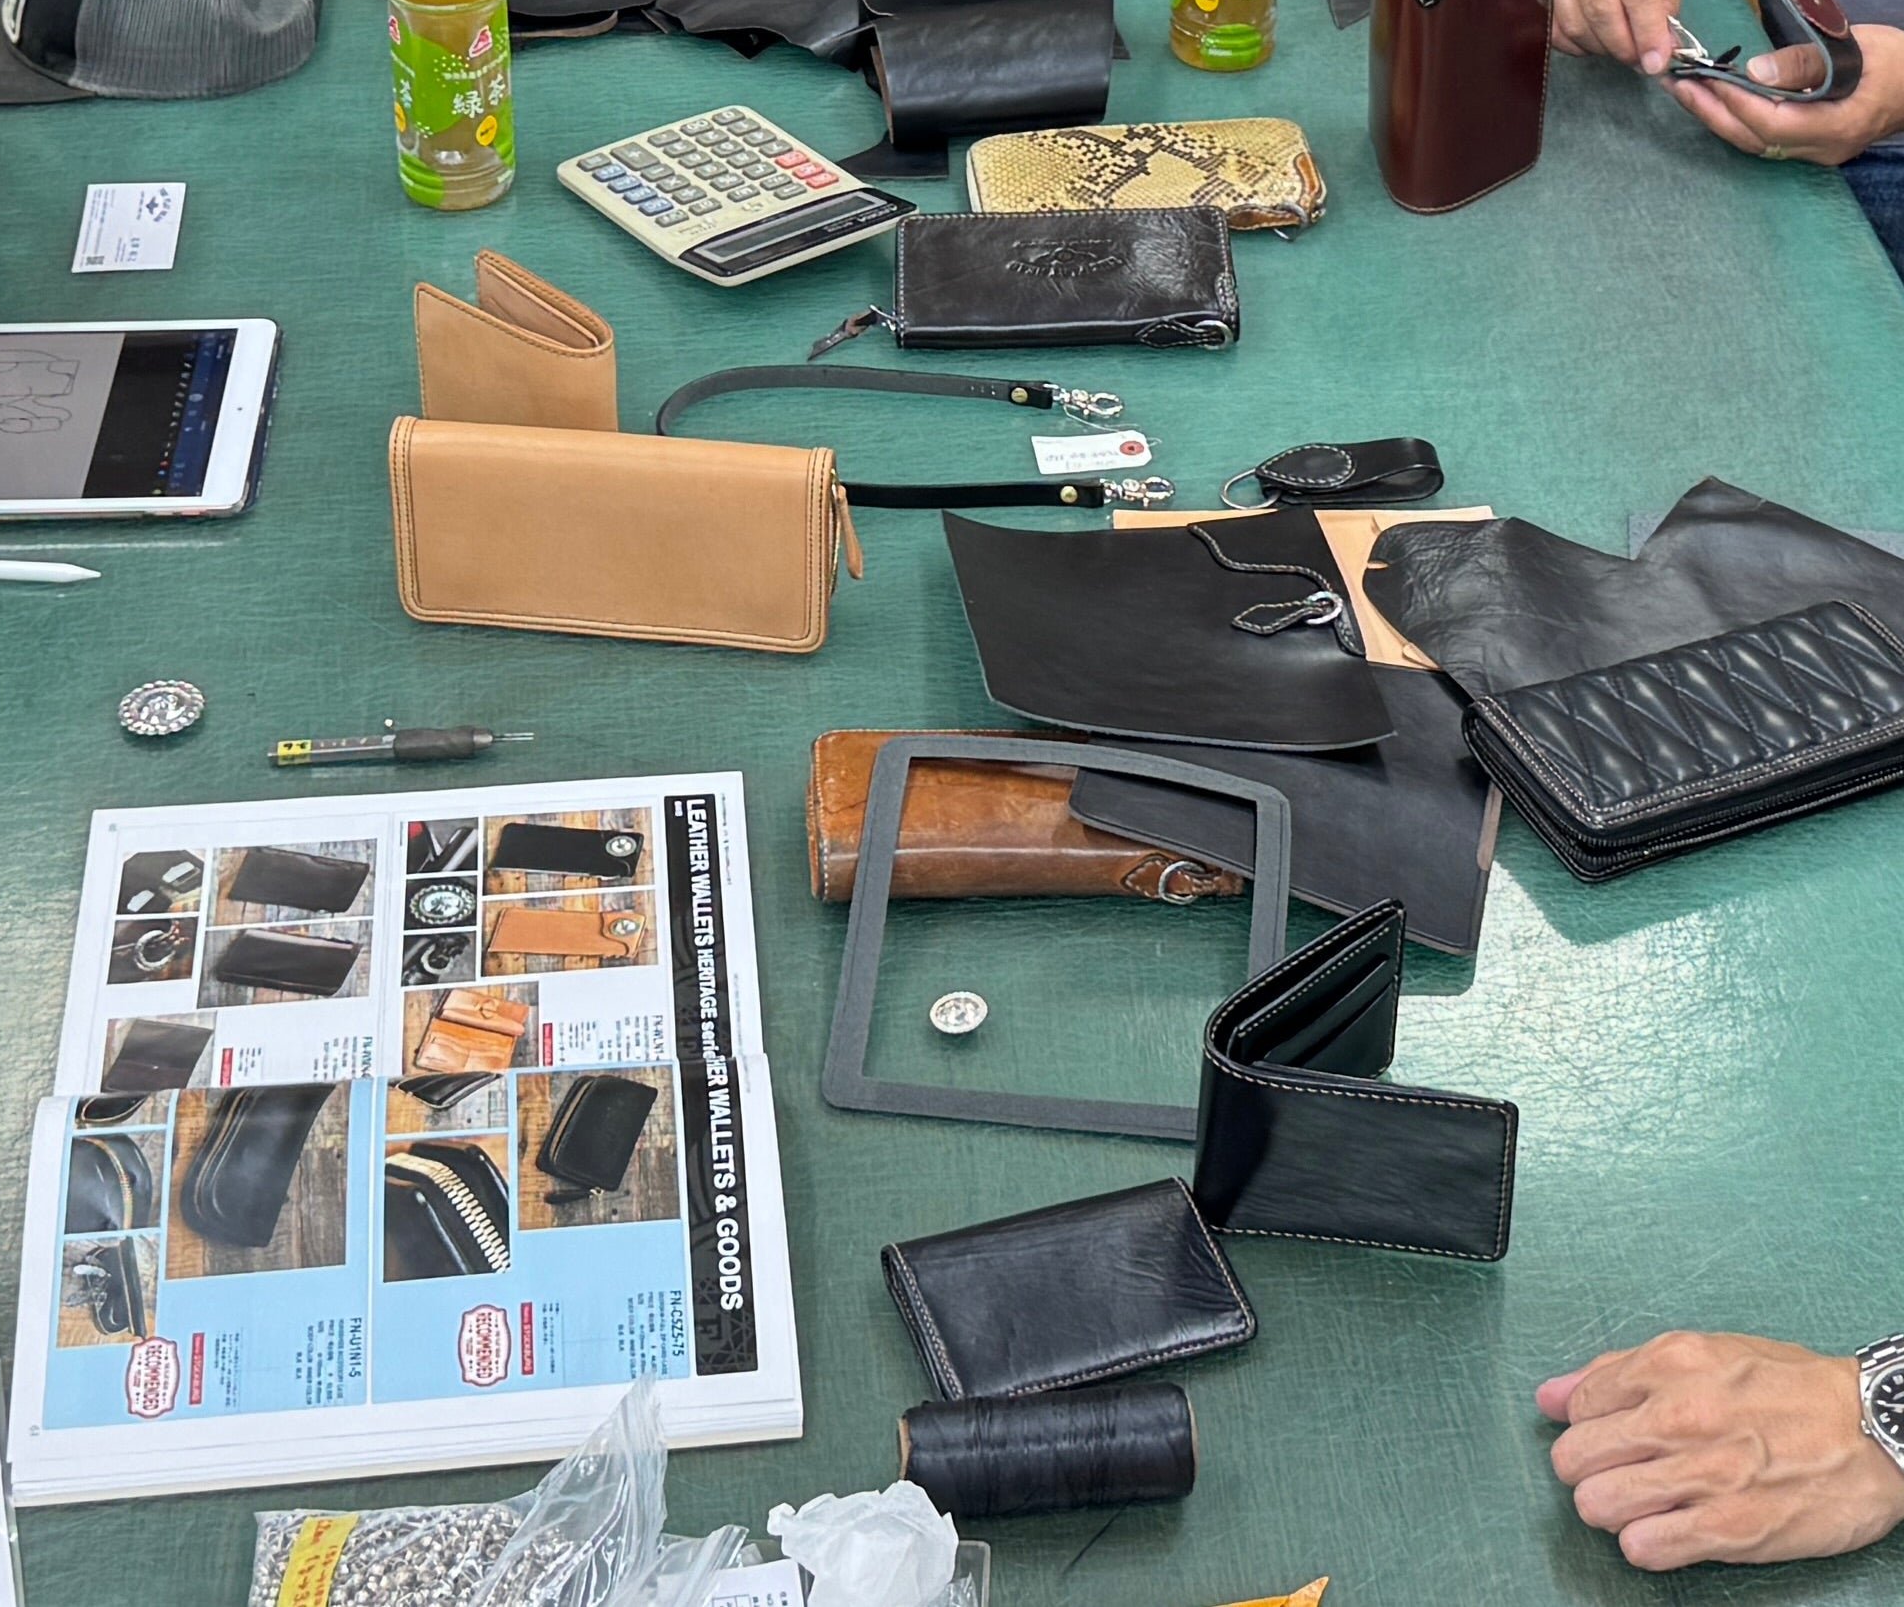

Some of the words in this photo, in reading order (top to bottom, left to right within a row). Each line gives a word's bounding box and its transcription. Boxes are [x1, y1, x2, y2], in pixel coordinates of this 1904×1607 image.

[451, 73, 507, 119] 緑茶
[686, 799, 711, 872] LEATHER
[690, 874, 714, 946] WALLETS
[696, 948, 717, 1018] HERITAGE
[701, 1021, 718, 1058] serie
[708, 1088, 736, 1189] WALLETS
[715, 1194, 737, 1213] &
[716, 1218, 744, 1310] GOODS
[143, 1345, 162, 1410] RECOMMENDED
[476, 1312, 492, 1378] RECOMMENDED
